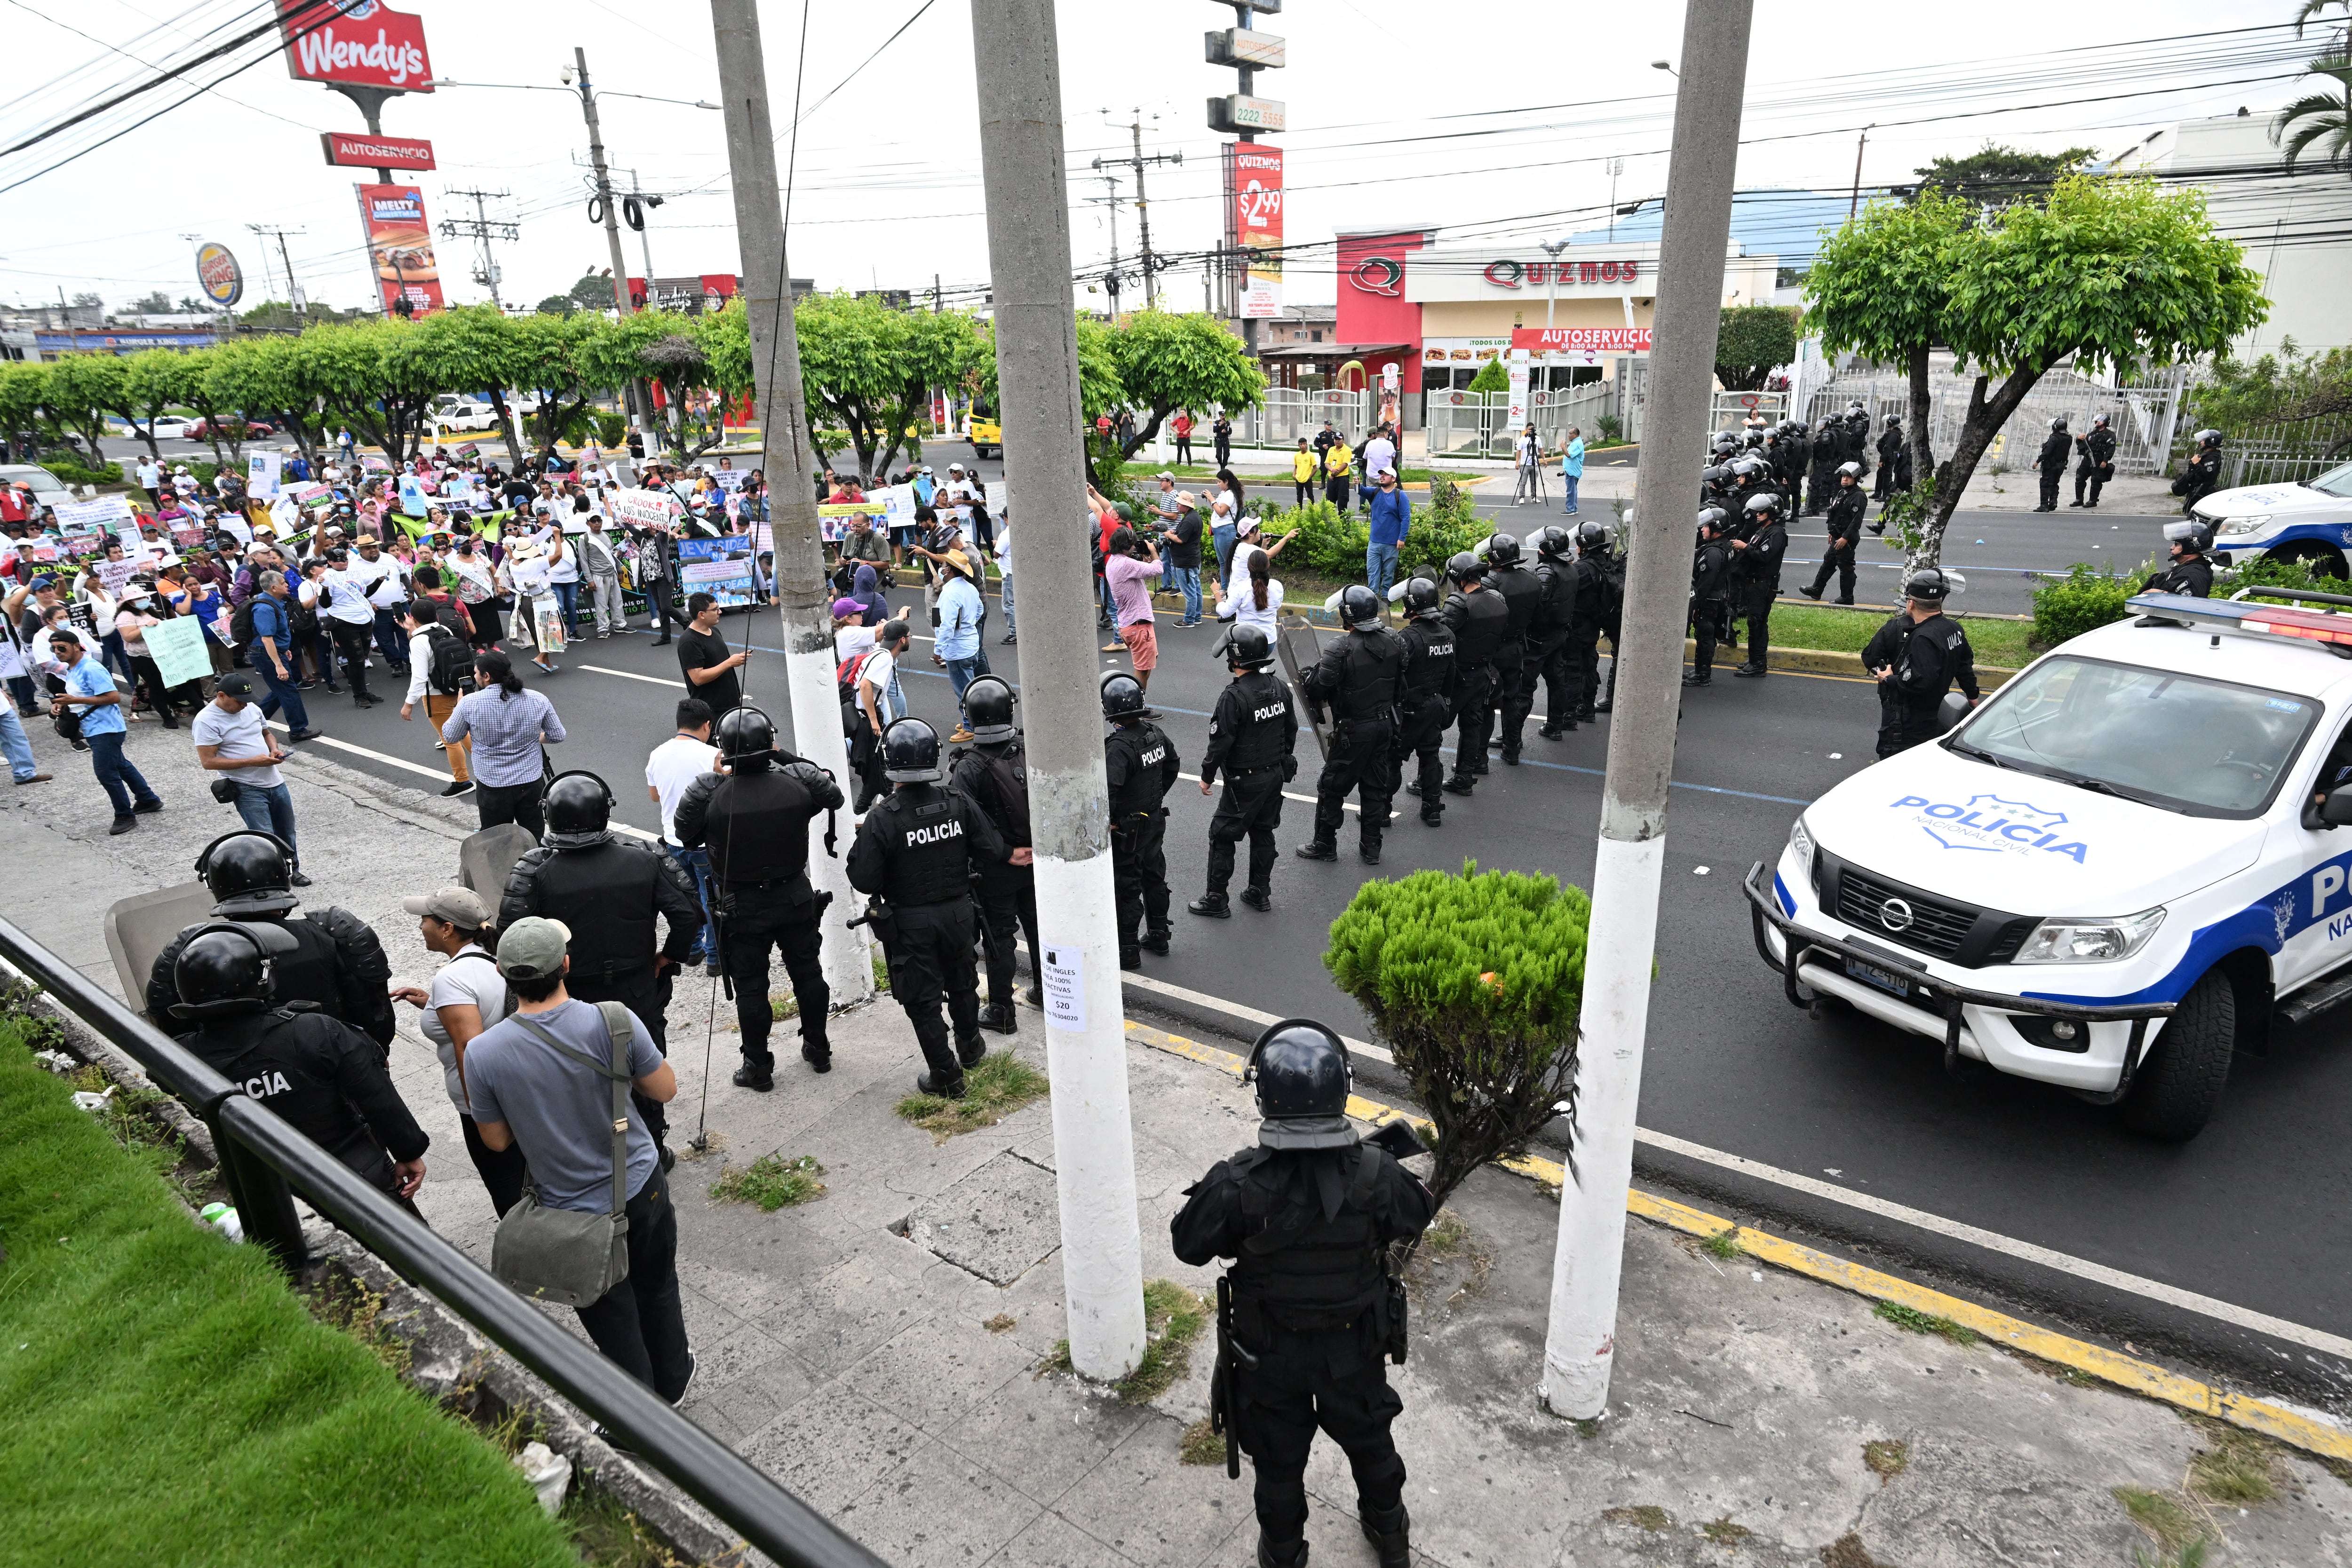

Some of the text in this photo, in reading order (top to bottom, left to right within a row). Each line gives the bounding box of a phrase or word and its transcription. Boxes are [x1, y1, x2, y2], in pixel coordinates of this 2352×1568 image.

[295, 27, 423, 84] Wendy's
[1237, 39, 1284, 56] AUTOSERVICIO
[1248, 101, 1273, 111] DELIVERY
[1238, 108, 1283, 126] 2222 5555
[341, 143, 429, 159] AUTOSERVICIO
[1238, 155, 1280, 171] QUIZNOS
[374, 200, 414, 211] MELTY
[1240, 179, 1280, 227] $2.99
[201, 254, 227, 277] BURGER
[206, 265, 234, 292] KING
[624, 506, 635, 516] LOS
[1429, 642, 1454, 656] POLICÍA
[1255, 701, 1285, 721] POLICÍA
[1142, 744, 1165, 766] POLICÍA
[906, 819, 963, 847] POLICÍA
[1889, 796, 2088, 864] POLICIA
[1912, 816, 2029, 855] NACIONAL CIVIL
[2312, 863, 2352, 918] P
[1882, 910, 1908, 923] NISSAN
[1056, 1001, 1070, 1010] $20
[1052, 1012, 1078, 1021] 76304020
